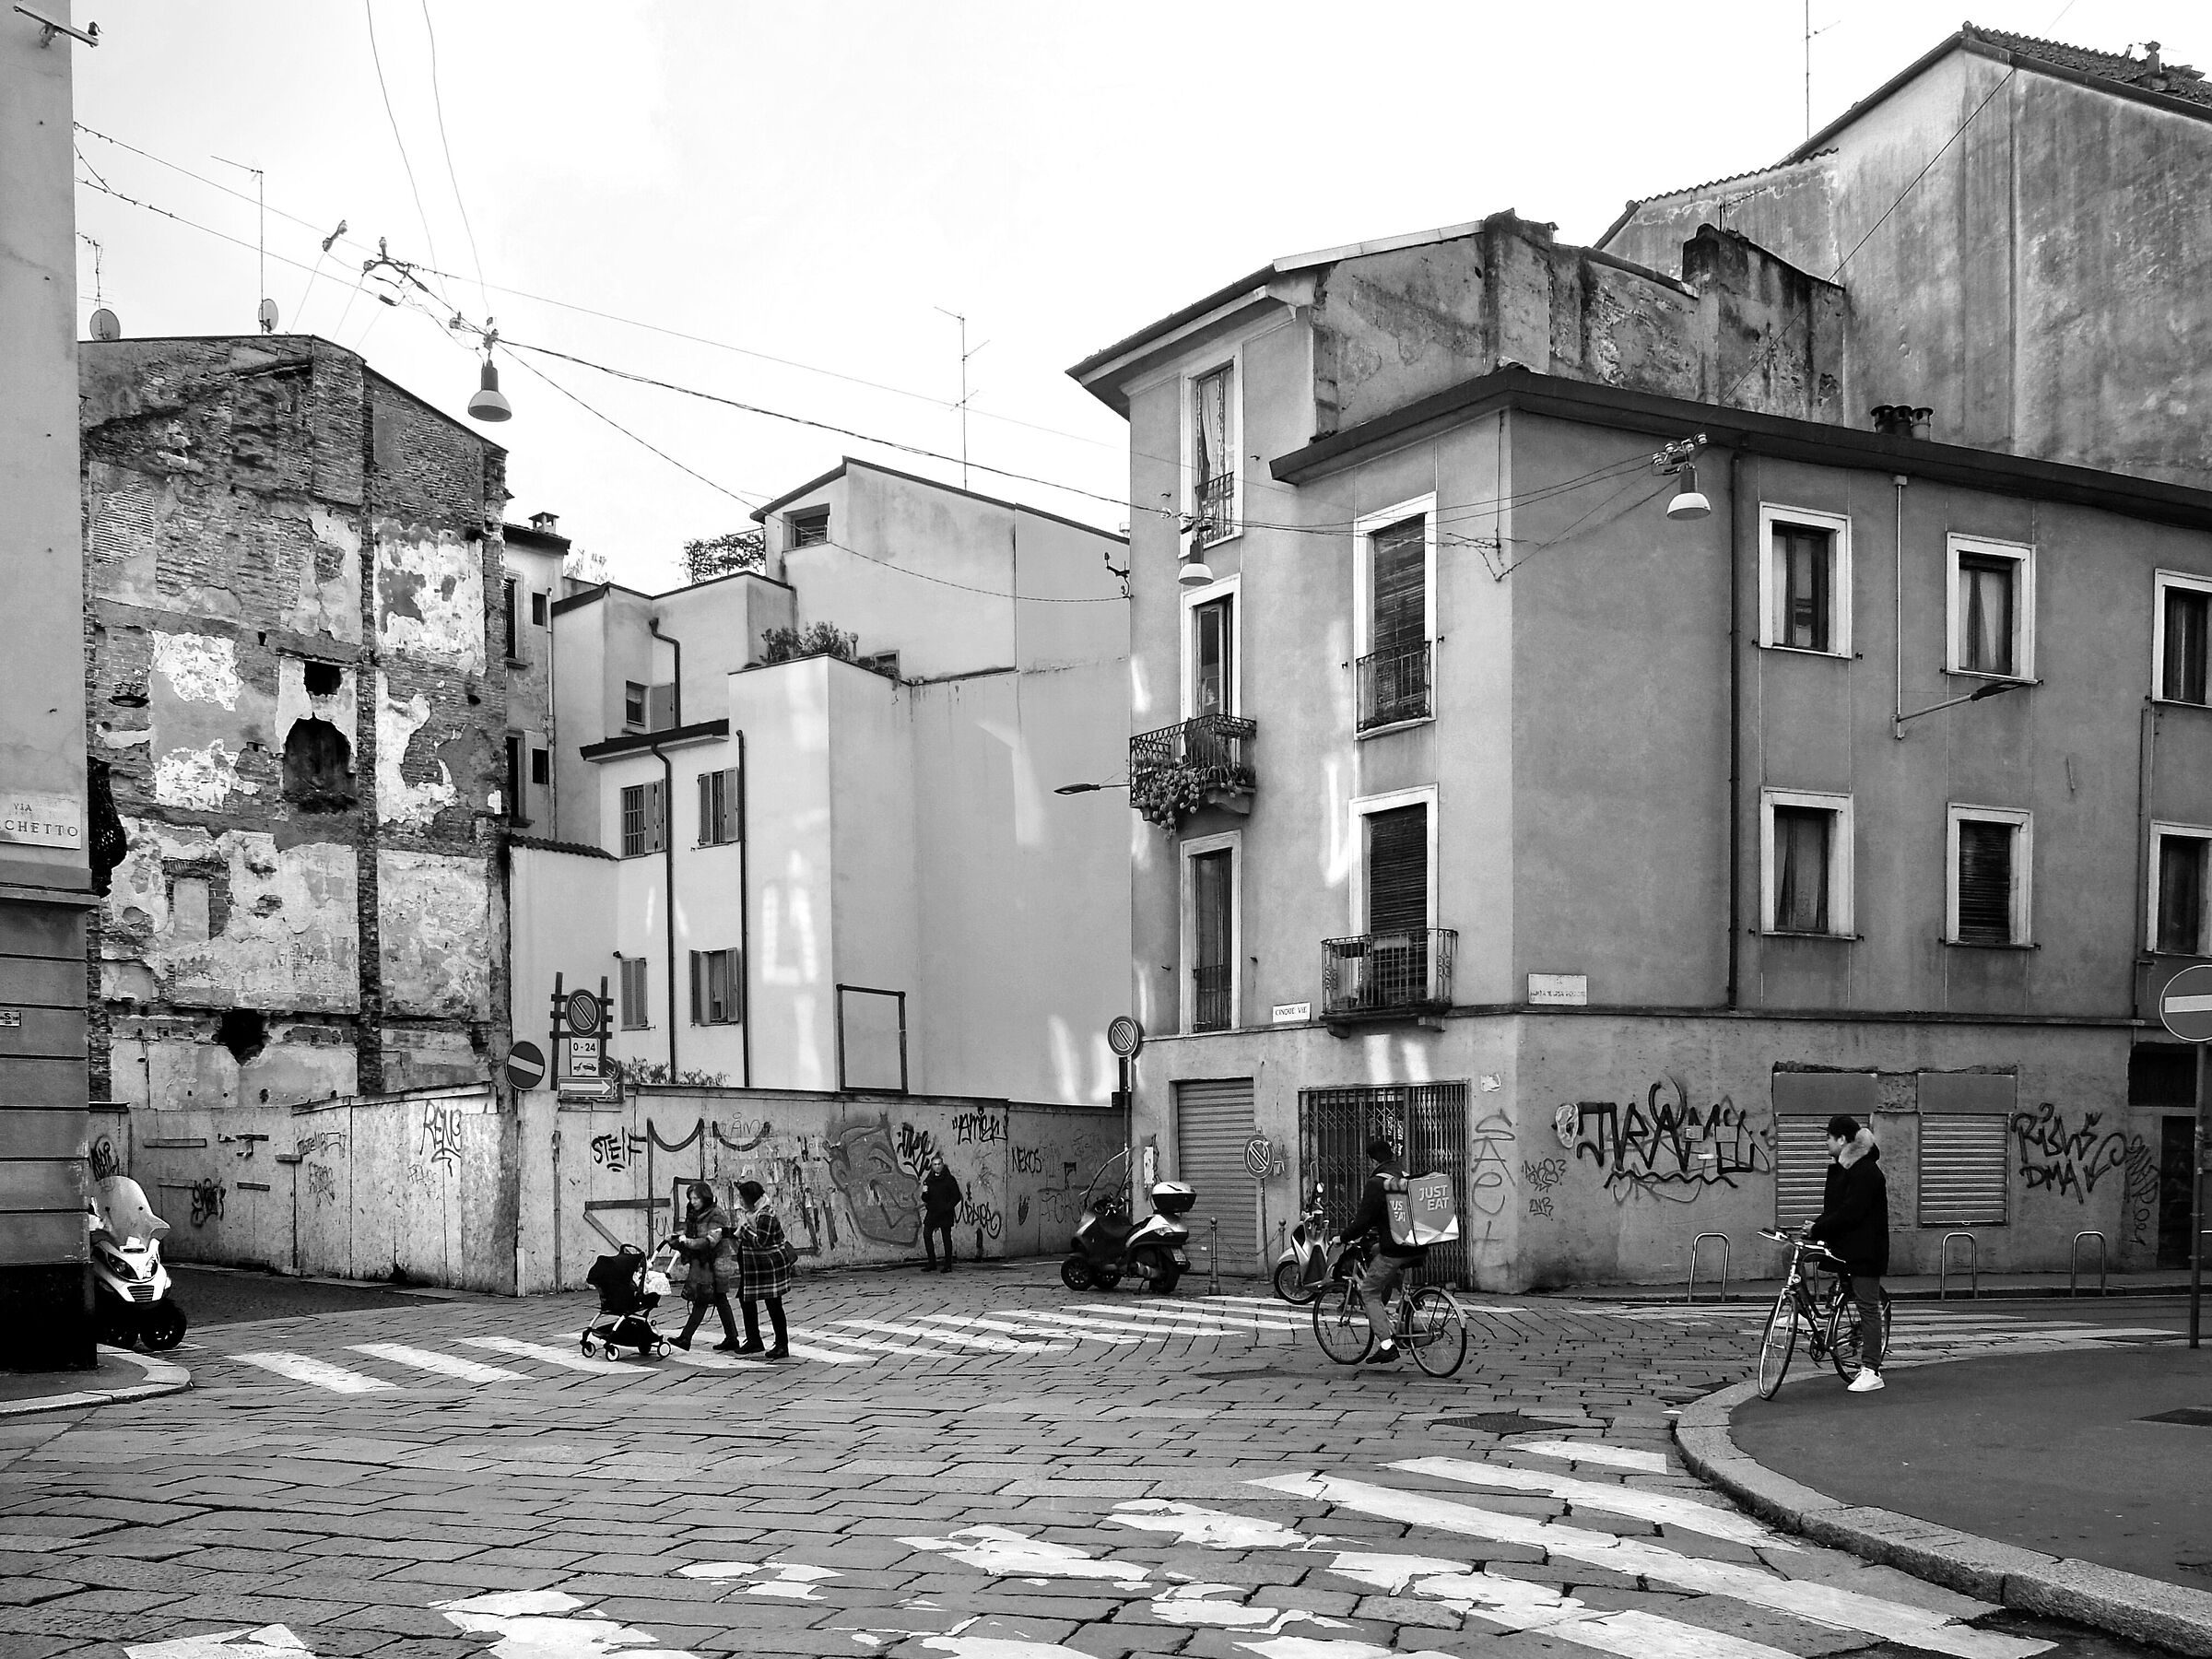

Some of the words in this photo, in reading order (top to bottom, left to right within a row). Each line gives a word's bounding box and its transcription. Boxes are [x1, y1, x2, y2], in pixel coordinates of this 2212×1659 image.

[13, 803, 32, 812] VIA
[0, 819, 78, 837] CHETTO
[1419, 1184, 1448, 1201] JUST
[1427, 1196, 1450, 1211] EAT
